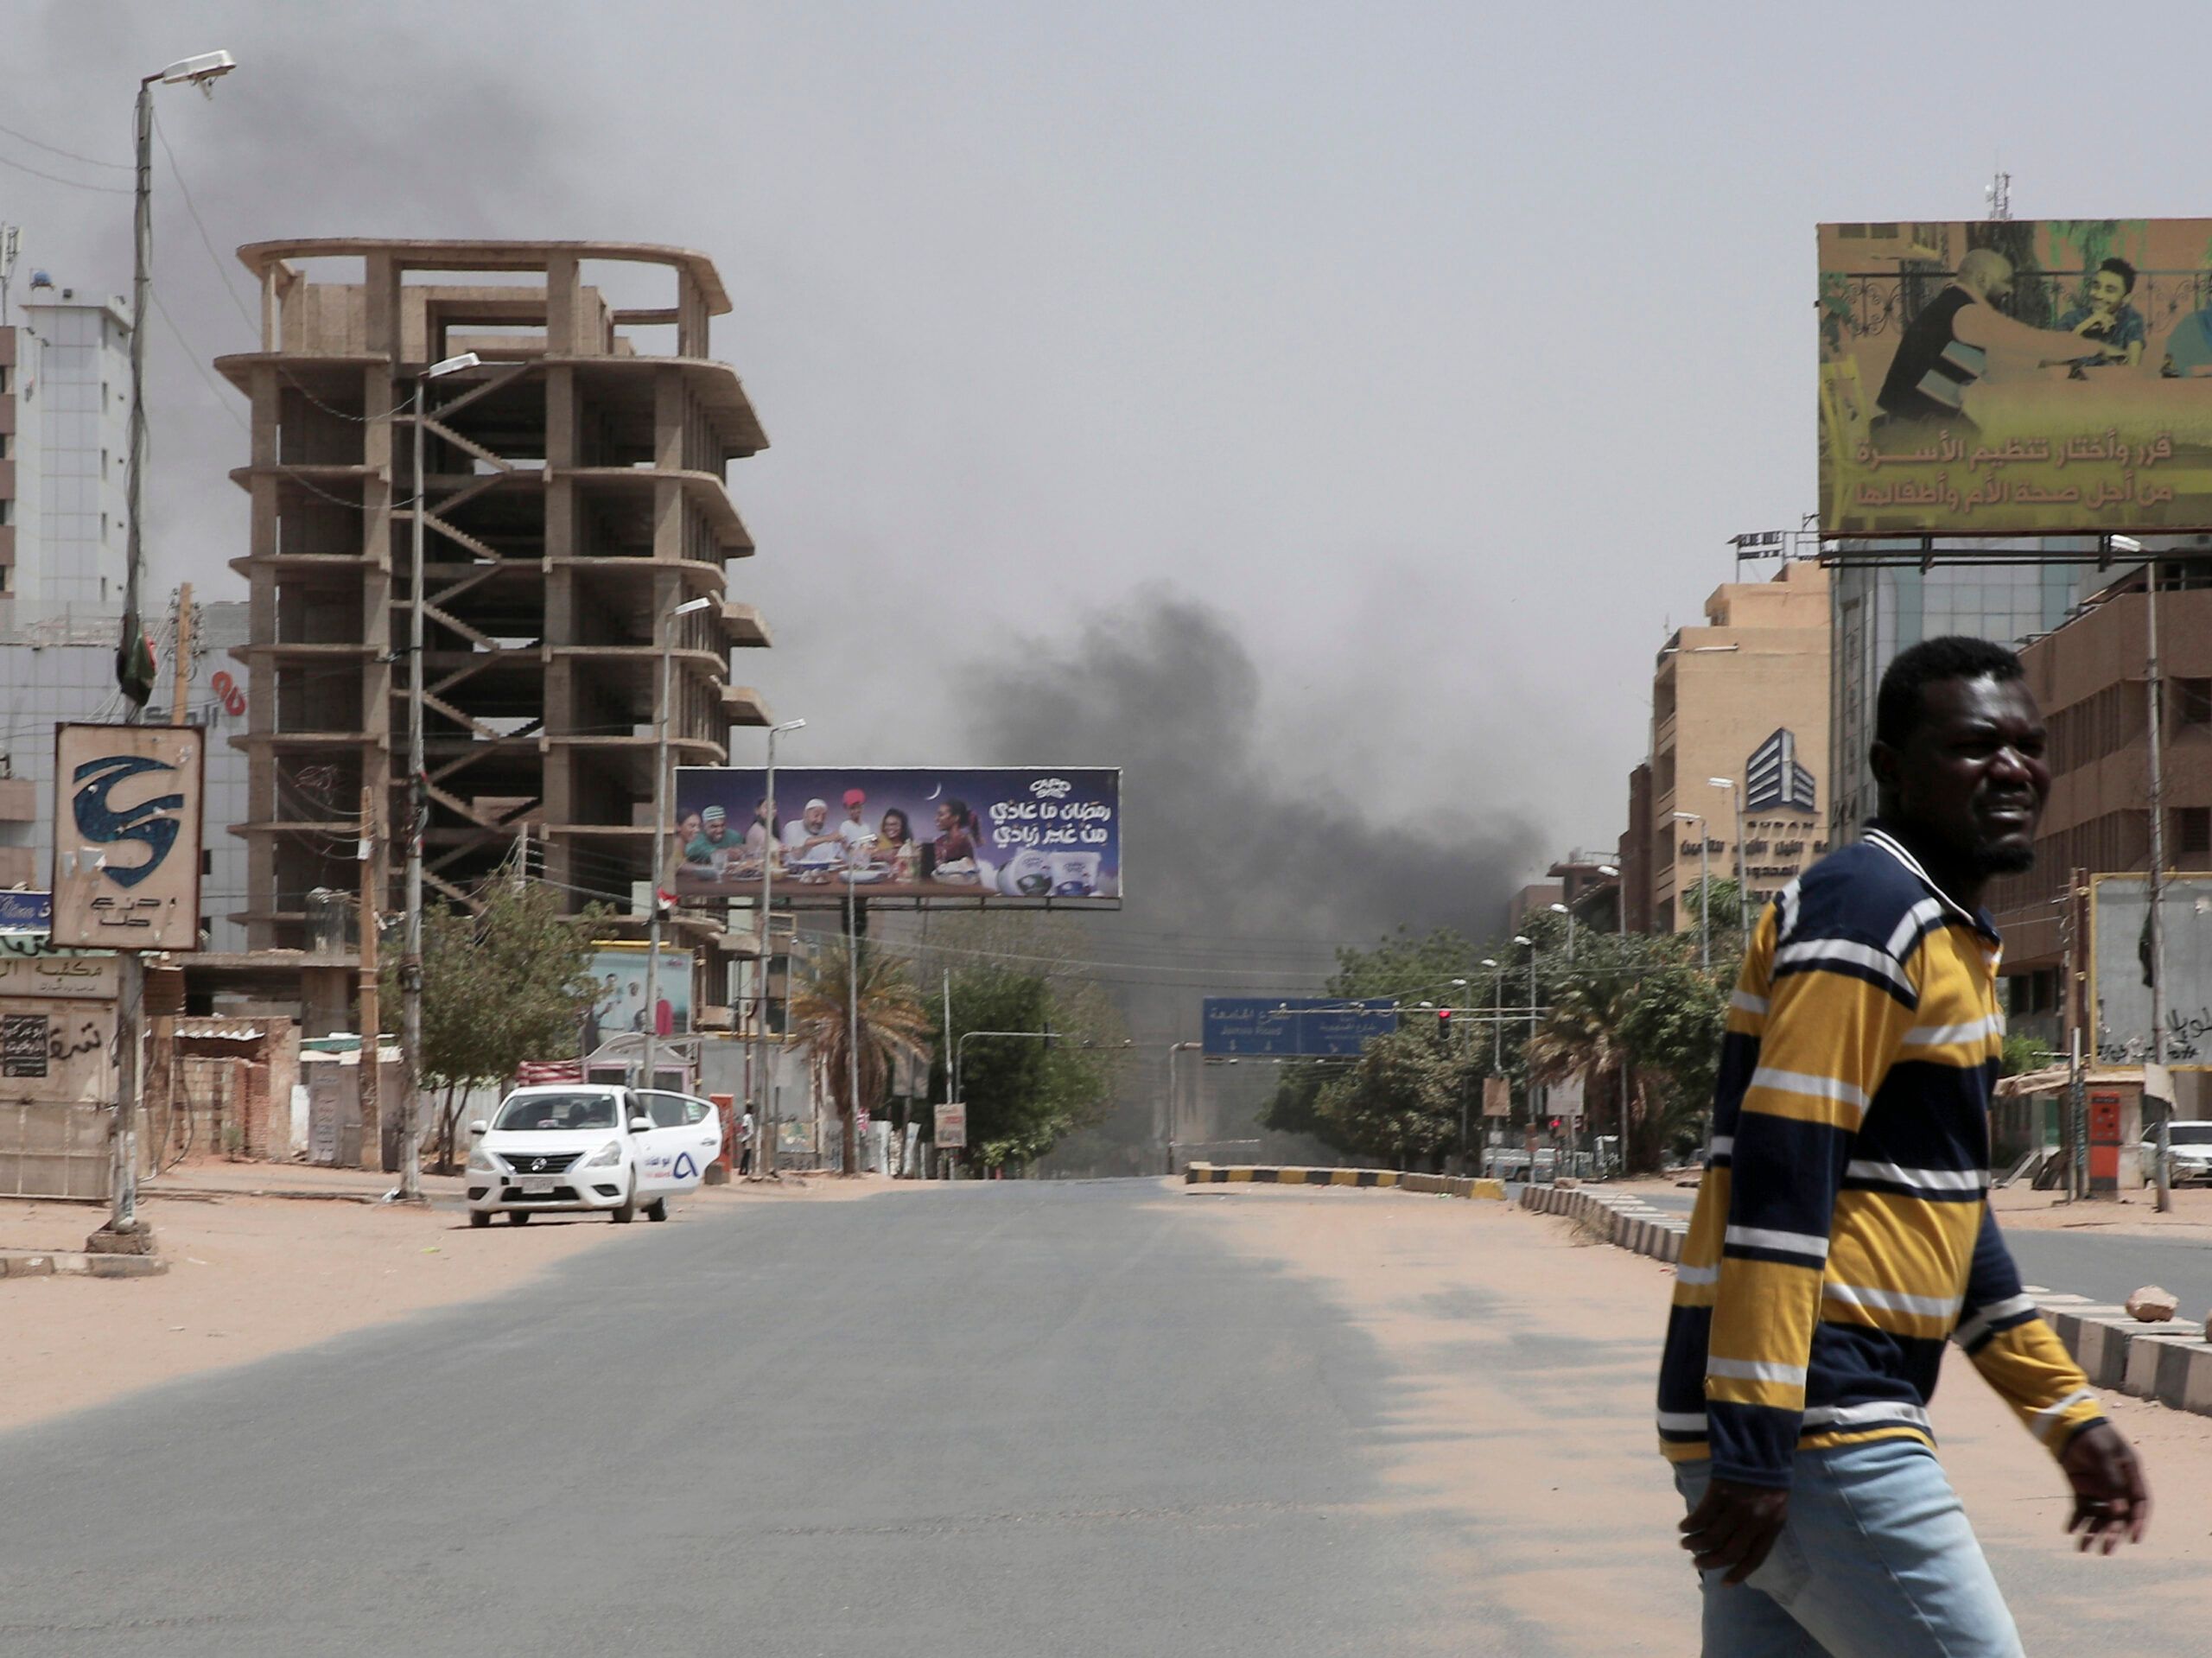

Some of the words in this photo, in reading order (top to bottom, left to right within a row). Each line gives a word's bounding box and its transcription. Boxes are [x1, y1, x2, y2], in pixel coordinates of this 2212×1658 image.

[1855, 430, 1965, 472] الأسرة
[1969, 438, 2050, 471] تنظيم
[2136, 432, 2172, 467] قرر
[1855, 472, 1961, 511] وأطفالها
[1962, 472, 2010, 513] الأم
[2014, 480, 2080, 503] صحة
[2084, 470, 2133, 510] أجل
[2138, 484, 2173, 508] من
[988, 799, 1038, 825] عادي
[1039, 801, 1058, 820] ما
[1060, 800, 1112, 822] رمضان
[1042, 823, 1078, 845] غير
[1080, 823, 1109, 846] من
[35, 956, 103, 983] مكتبة
